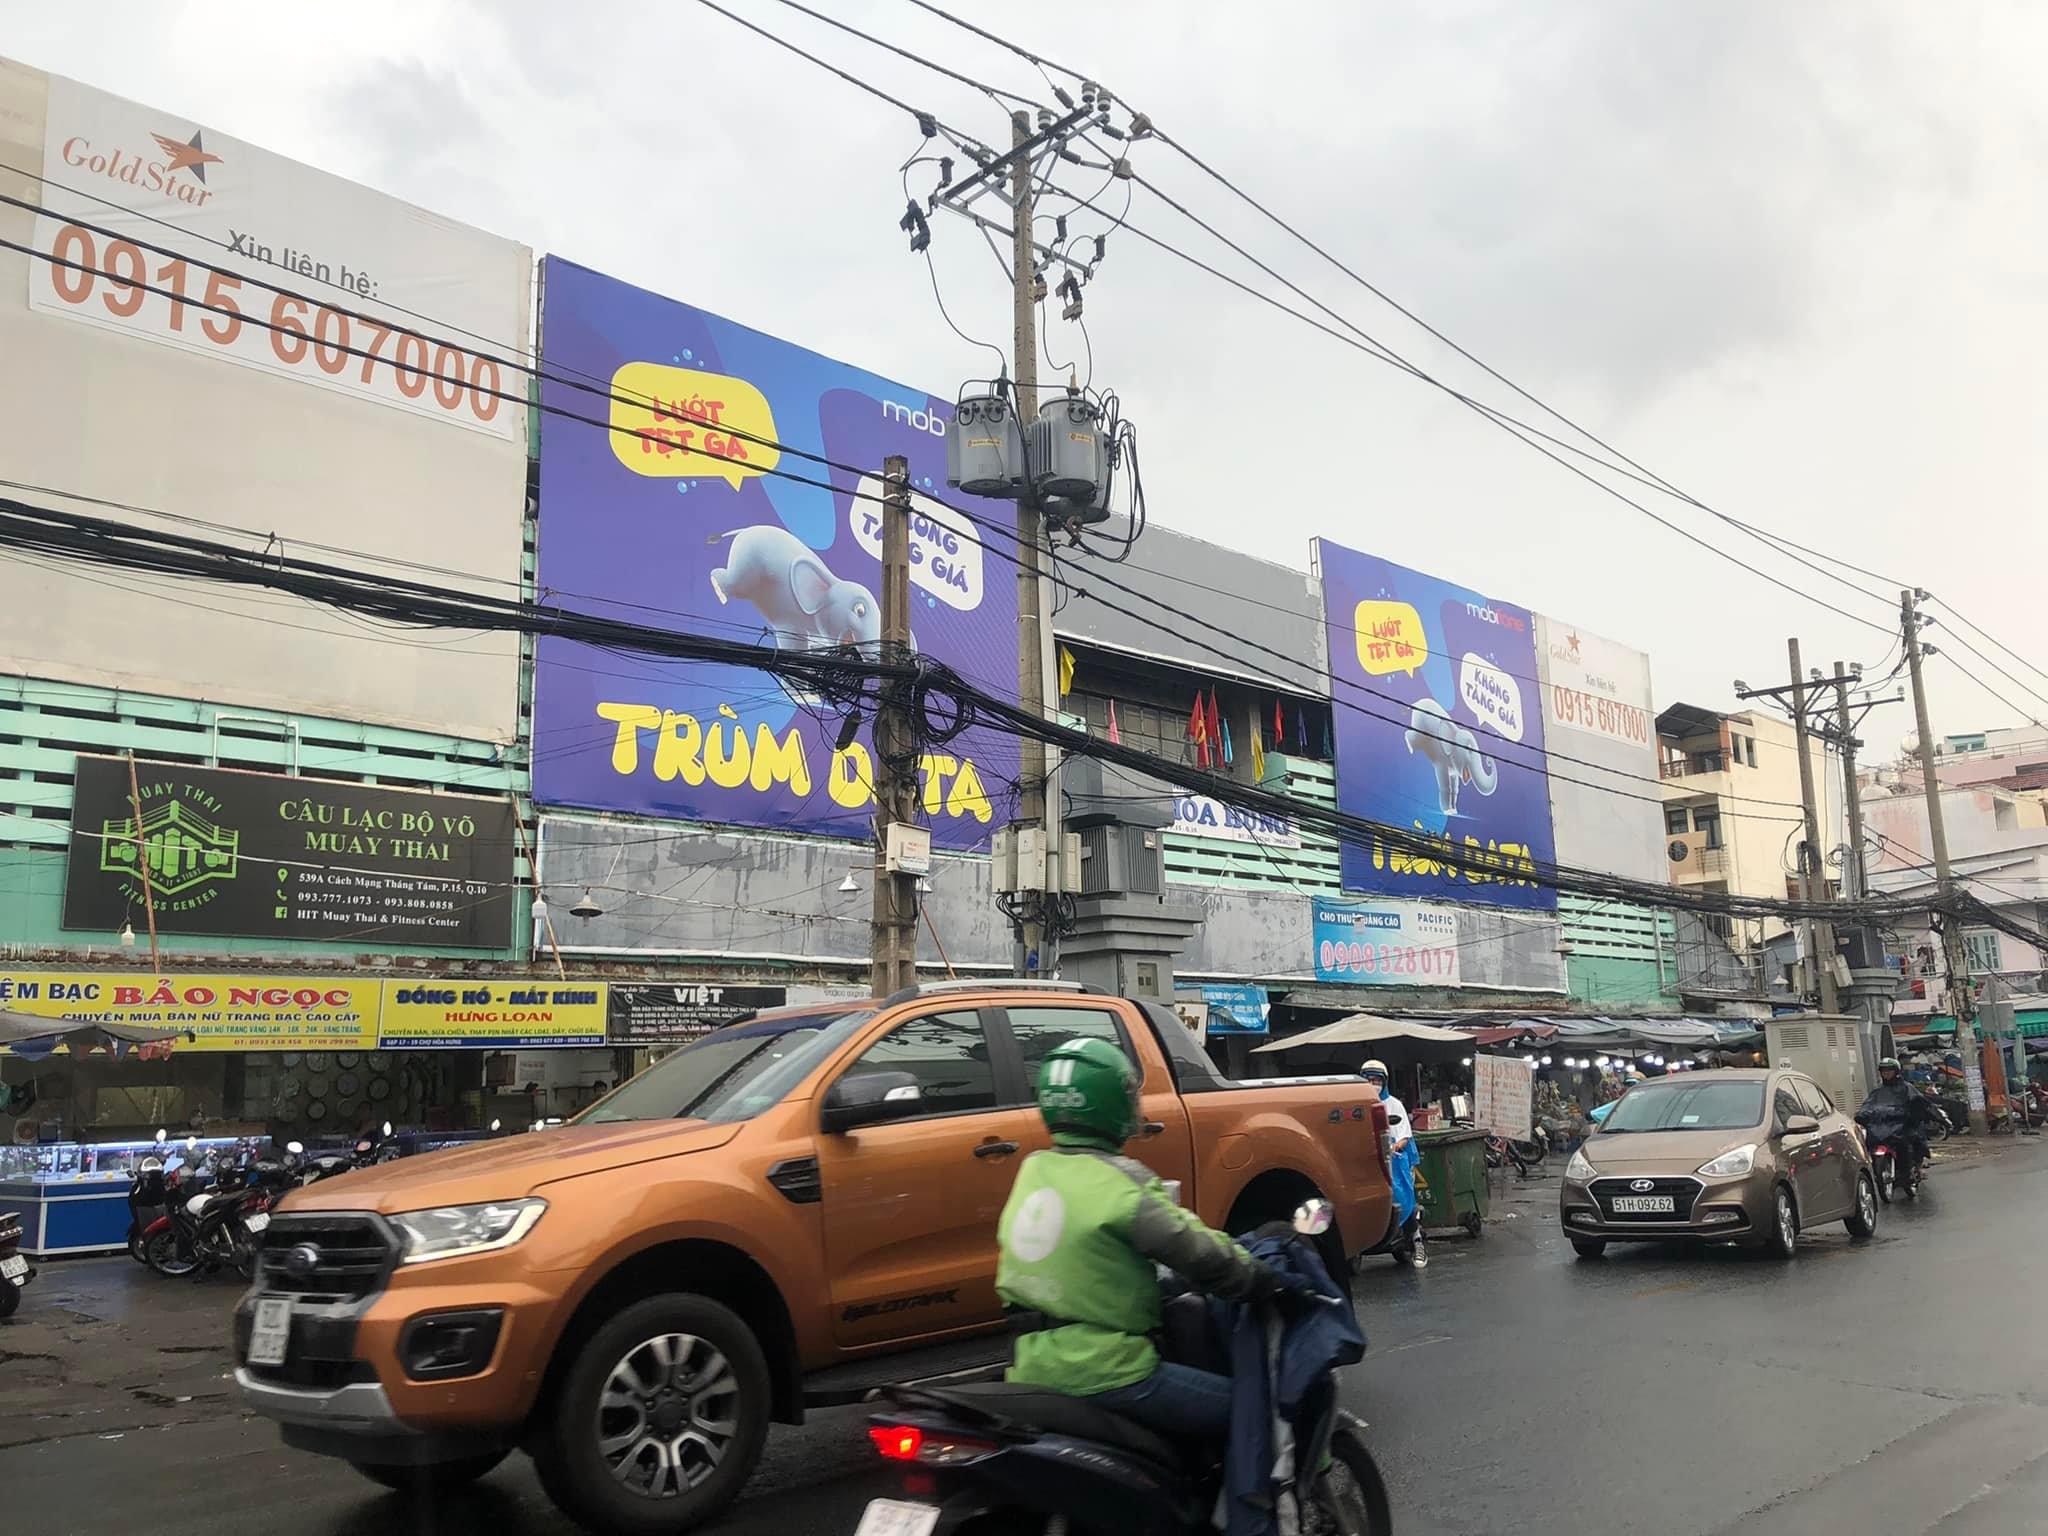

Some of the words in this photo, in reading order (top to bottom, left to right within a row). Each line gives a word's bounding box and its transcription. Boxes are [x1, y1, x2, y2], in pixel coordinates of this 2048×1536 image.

[227, 228, 273, 266] Xin
[281, 246, 330, 285] liên
[340, 264, 380, 299] hệ:
[50, 224, 243, 345] 0915
[269, 292, 501, 422] 607000
[653, 392, 725, 426] LƯỚT
[635, 427, 695, 460] TẸT
[930, 562, 969, 594] GIÁ
[1371, 617, 1402, 639] LƯỚT
[1466, 602, 1526, 633] mobifone
[1367, 642, 1392, 663] TẸT
[1473, 667, 1511, 706] KHÔNG
[1465, 681, 1497, 718] TĂNG
[1497, 701, 1518, 731] GIÁ
[1553, 685, 1594, 728] 0915
[1597, 697, 1648, 744] 607000
[596, 702, 812, 798] TRÙM
[827, 741, 993, 824] DTA
[184, 783, 223, 814] THAI
[278, 798, 335, 825] CÂU
[342, 807, 394, 833] LẠC
[400, 810, 435, 837] BỘ
[441, 814, 476, 838] VÕ
[304, 831, 383, 856] MUAY
[390, 839, 451, 861] THAI
[298, 872, 325, 884] 539A
[327, 874, 352, 886] Cách
[354, 877, 382, 889] Mạng
[384, 879, 415, 892] Tháng
[173, 887, 219, 912] CENTER
[297, 909, 320, 920] HIT
[322, 910, 351, 923] Muay
[354, 912, 377, 923] Thai
[380, 914, 389, 924] &
[428, 916, 461, 928] Center
[1319, 911, 1336, 922] CHO
[1384, 917, 1400, 928] CÁO
[1417, 912, 1454, 926] PACIFIC
[1320, 940, 1377, 974] 0908
[1379, 944, 1418, 976] 328
[1420, 947, 1456, 976] 017
[49, 982, 100, 1004] BẠC
[112, 978, 217, 1007] BẢO
[227, 987, 351, 1010] NGỌC
[673, 984, 724, 1006] VIỆT
[130, 1012, 162, 1022] MUA
[227, 1012, 271, 1022] TRANG
[306, 1012, 331, 1022] CAO
[445, 1011, 498, 1022] HƯNG
[502, 1012, 553, 1022] LOAN
